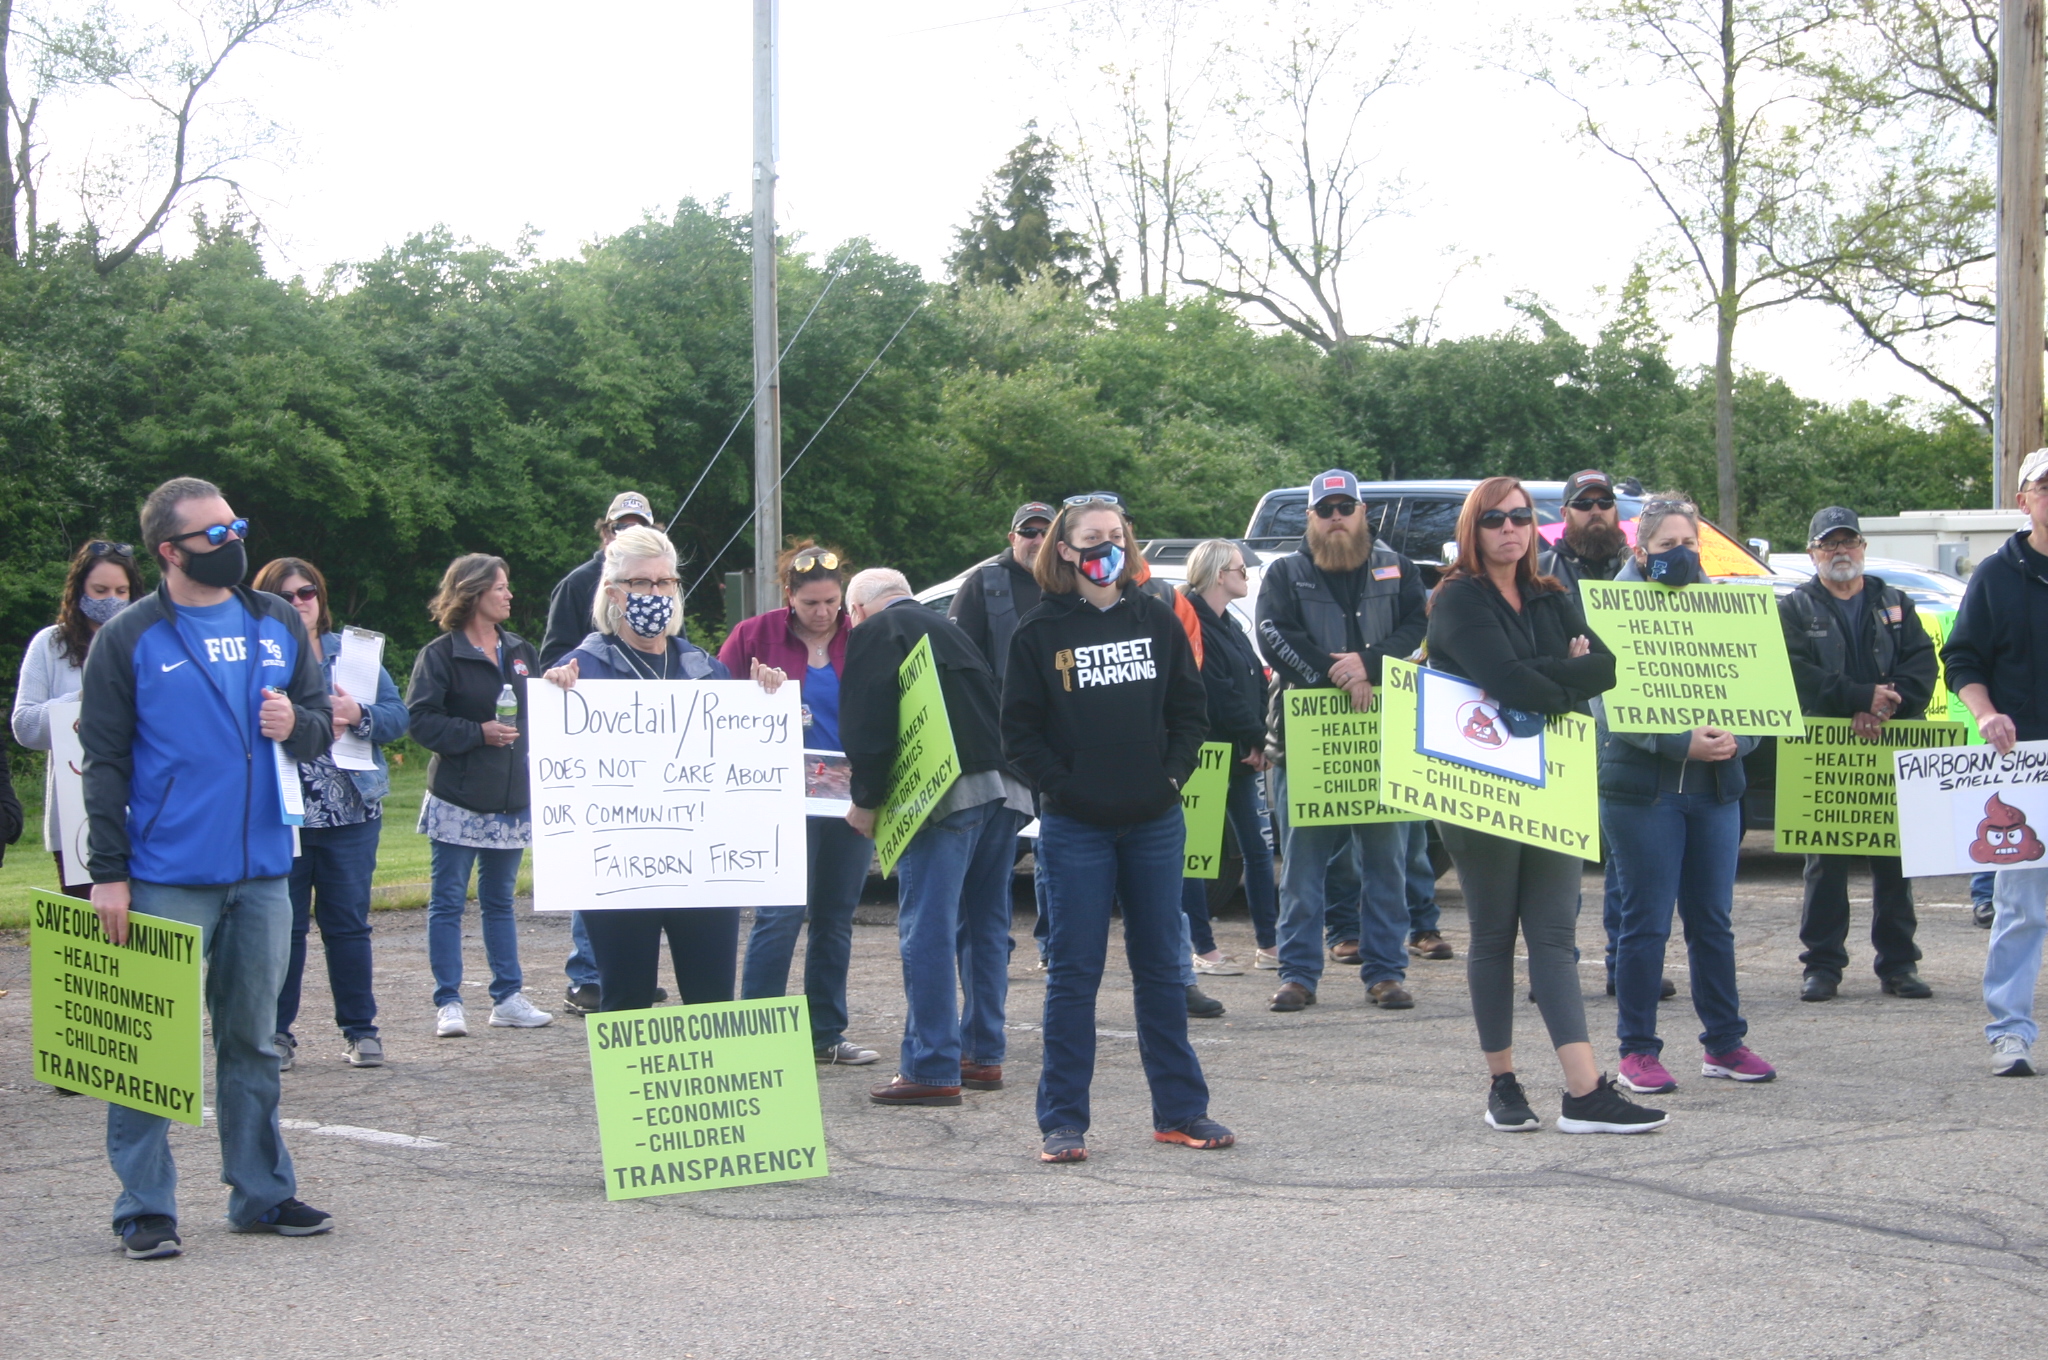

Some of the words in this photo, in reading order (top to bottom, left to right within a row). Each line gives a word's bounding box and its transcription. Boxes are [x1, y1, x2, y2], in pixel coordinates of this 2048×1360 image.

[1589, 587, 1633, 611] SAVE
[1633, 590, 1669, 612] OUR
[1667, 590, 1768, 615] COMMUNITY
[1074, 637, 1152, 669] STREET
[1077, 660, 1157, 689] PARKING
[1291, 696, 1327, 716] SAVE
[1613, 706, 1793, 727] TRANSPARENCY
[1312, 739, 1381, 755] -ENVIRO
[539, 758, 586, 782] DOES
[599, 758, 647, 779] NOT
[663, 762, 716, 784] CARE
[725, 763, 789, 786] ABOUT
[1898, 751, 1995, 780] FAIRBORN
[1314, 778, 1381, 793] -CHILDR
[1940, 774, 2002, 790] SMELL
[543, 804, 576, 826] OUR
[586, 801, 705, 826] COMMUNITY!
[881, 754, 953, 866] TRANSPARENCY
[1388, 781, 1590, 850] TRANSPARENCY
[1782, 829, 1900, 848] TRANSPAR
[593, 843, 692, 878] FAIRBORN
[36, 899, 71, 935] SAVE
[73, 909, 100, 943] OUR
[597, 1019, 647, 1050] SAVE
[648, 1015, 687, 1045] OUR
[687, 1005, 800, 1041] COMMUNITY
[39, 1050, 195, 1114] TRANSPARENCY
[613, 1146, 816, 1189] TRANSPARENCY
